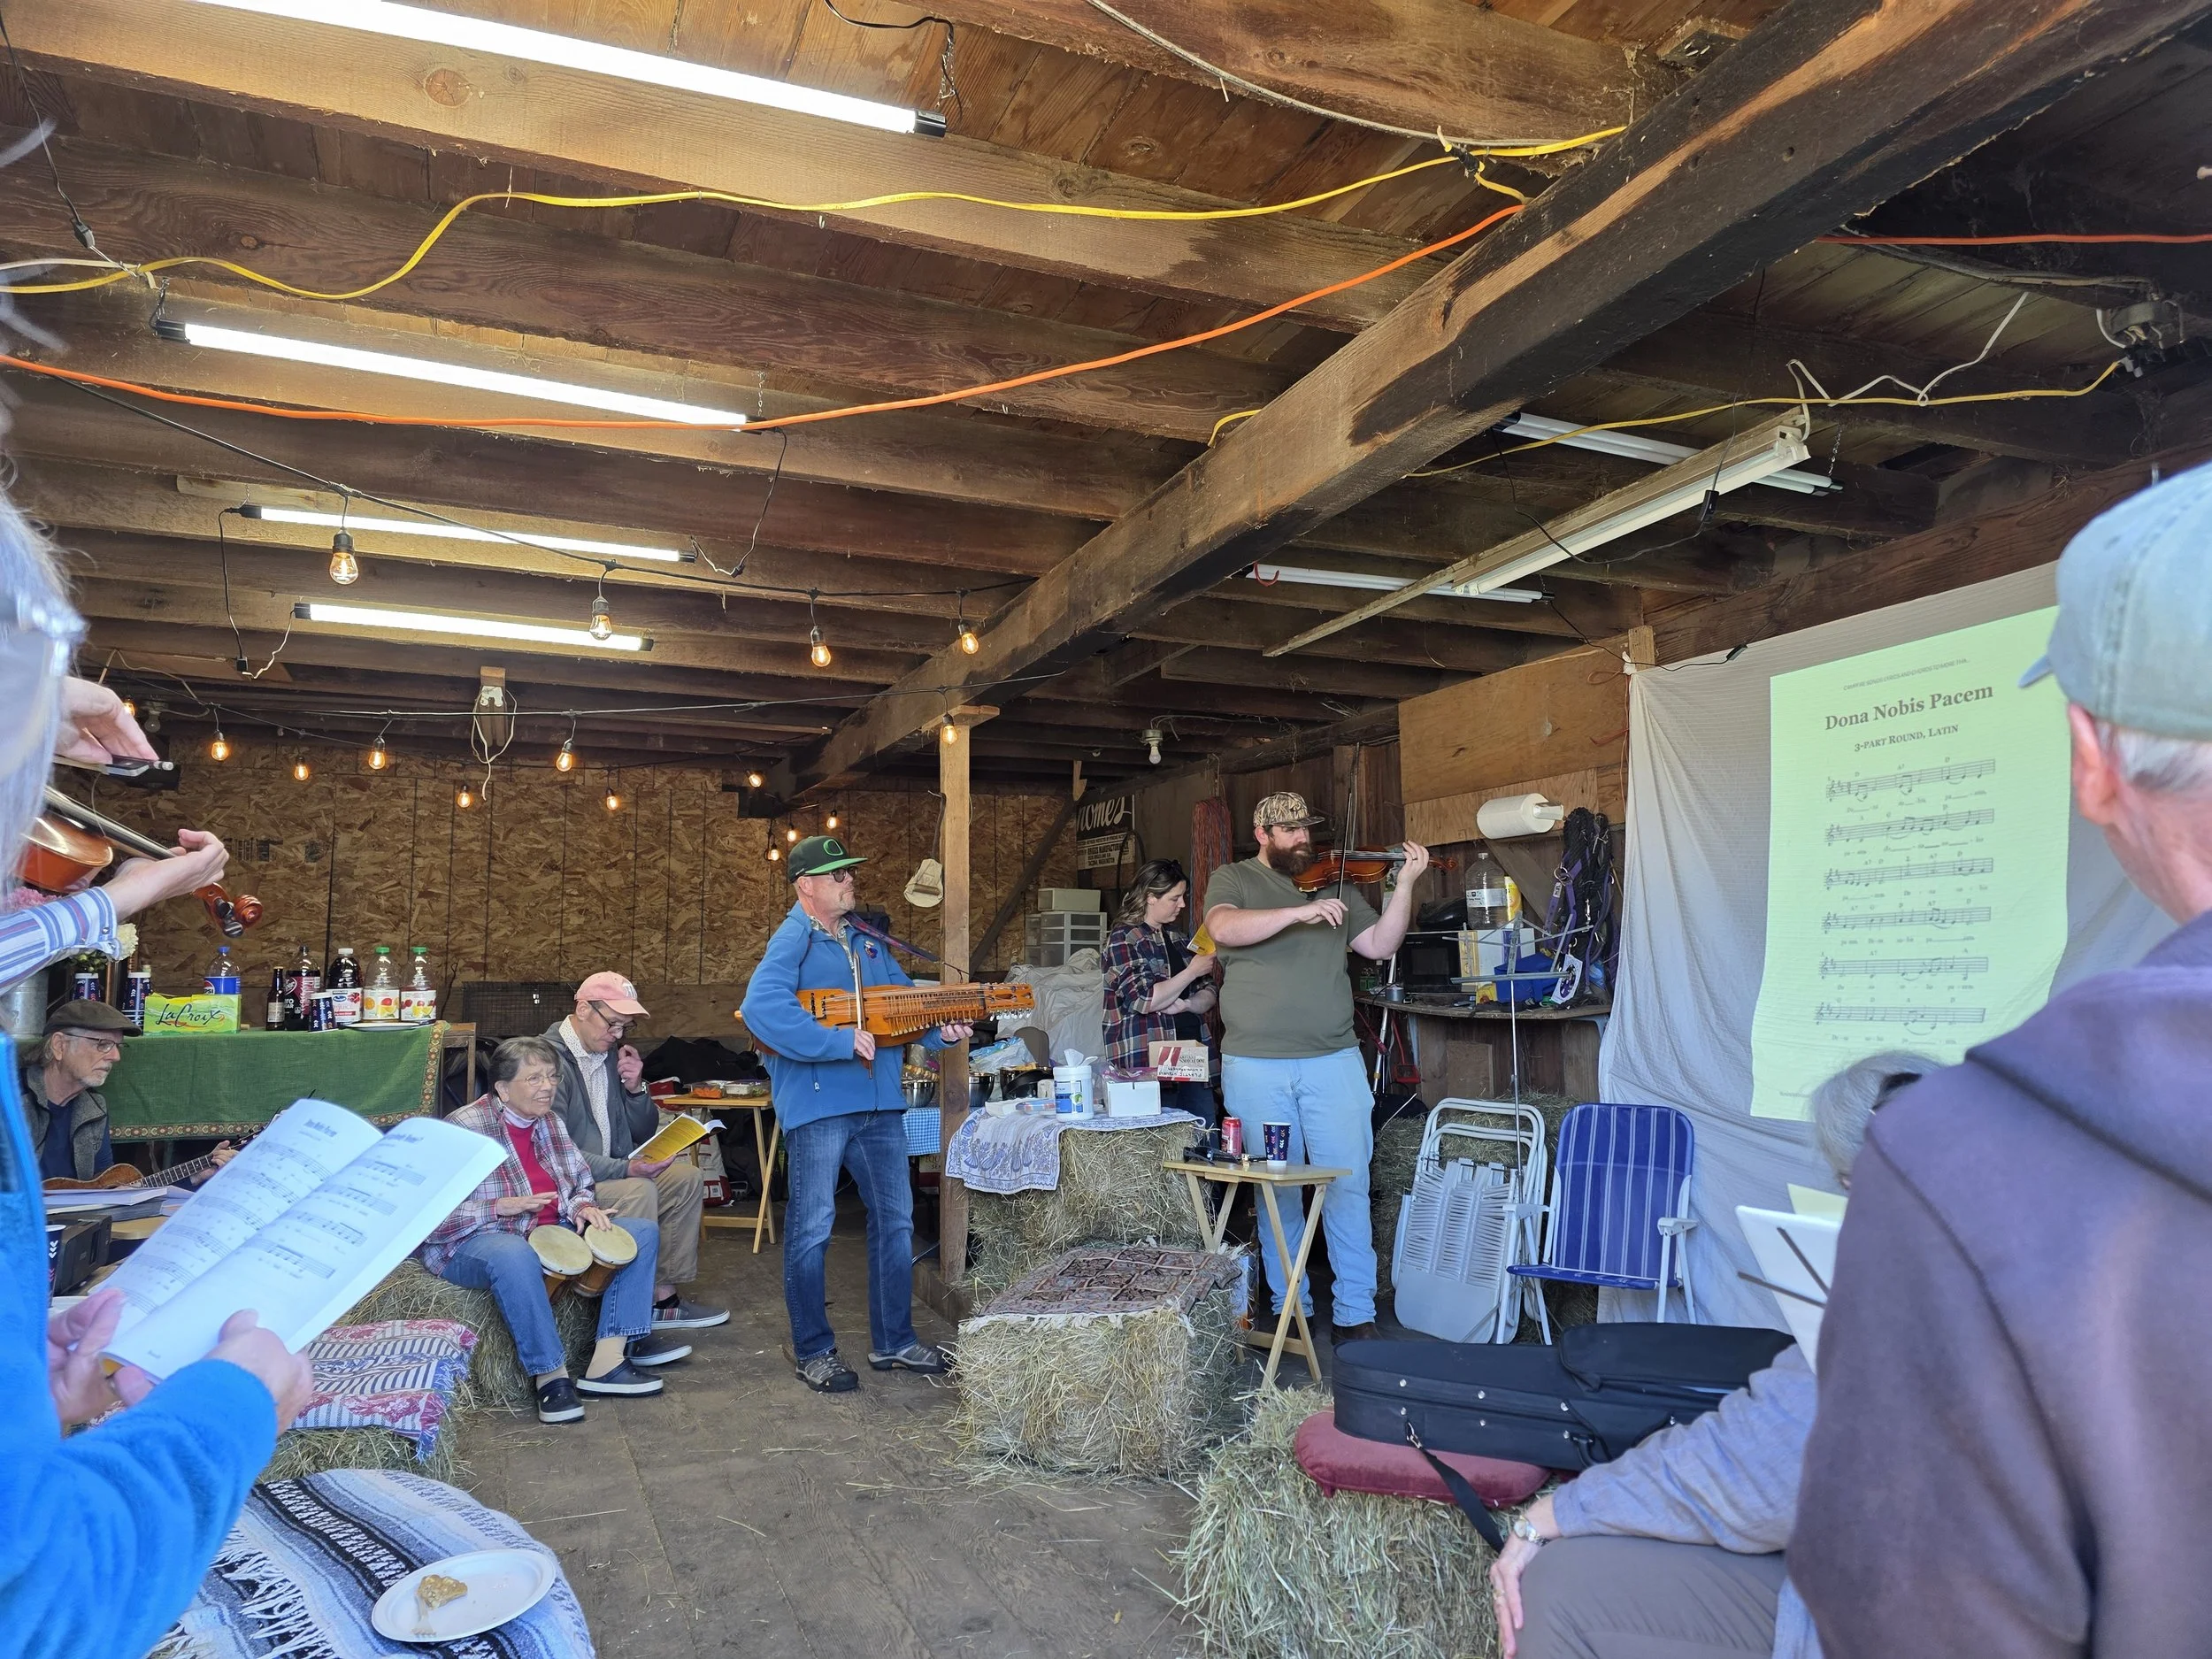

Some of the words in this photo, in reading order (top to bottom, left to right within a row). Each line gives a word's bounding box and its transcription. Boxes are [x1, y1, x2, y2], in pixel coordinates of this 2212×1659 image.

[1824, 712, 1869, 730] Dona
[1873, 697, 1925, 720] Nobis
[1929, 686, 1993, 710] Pacem
